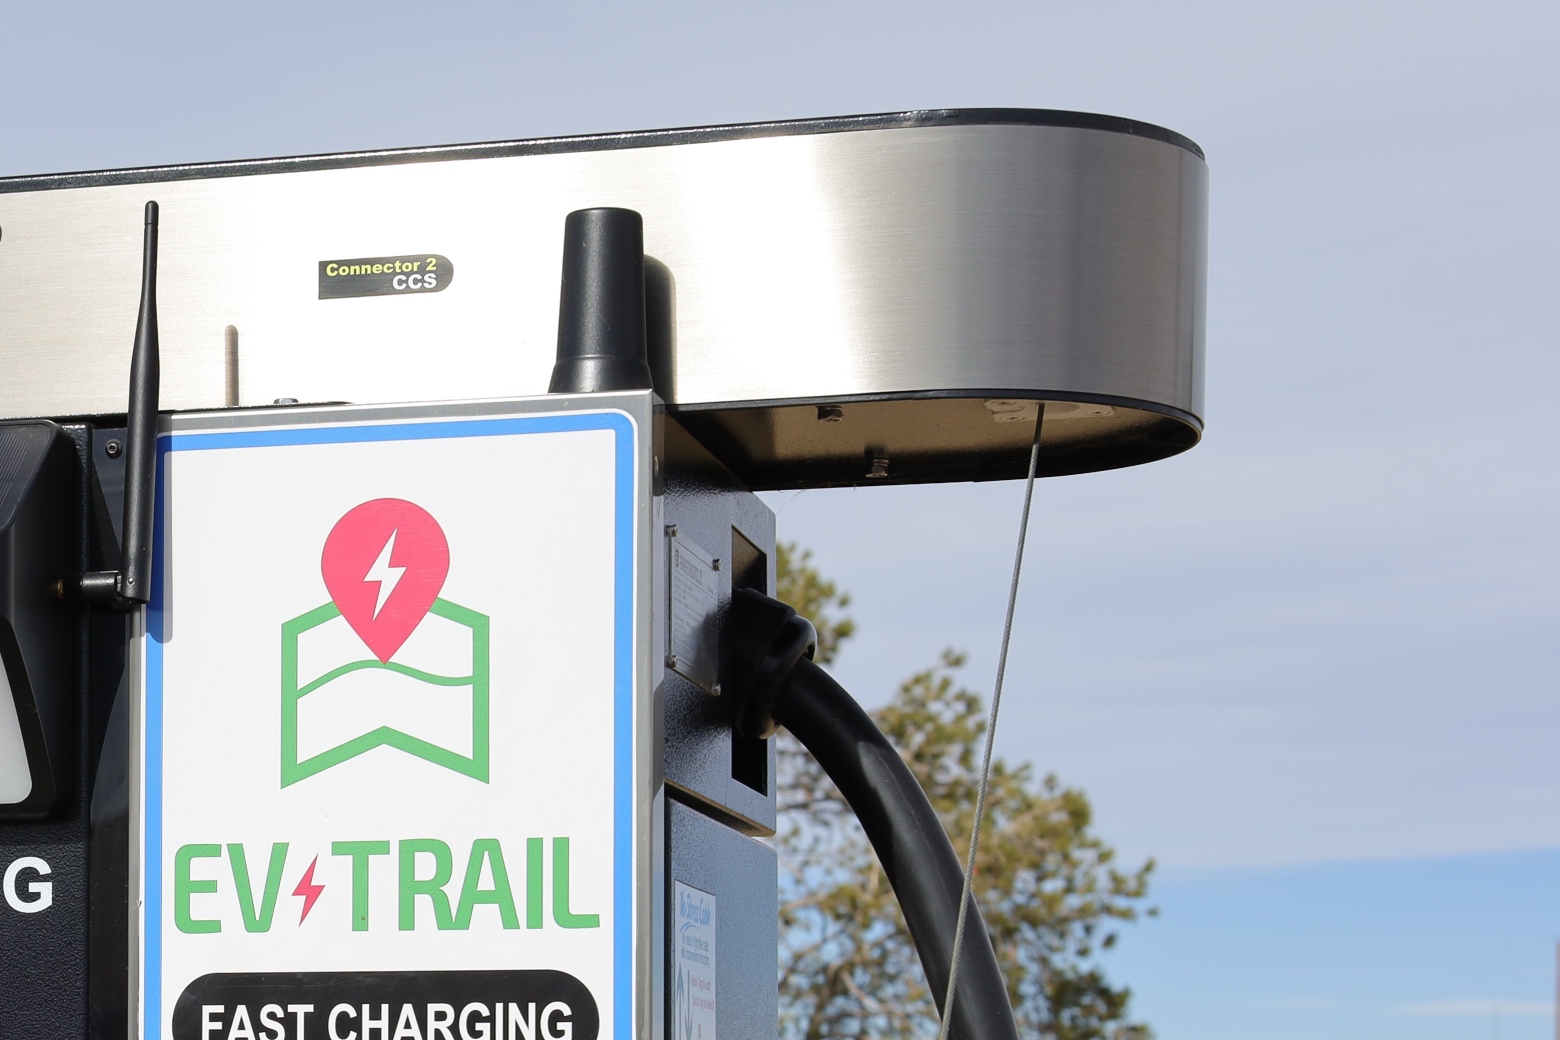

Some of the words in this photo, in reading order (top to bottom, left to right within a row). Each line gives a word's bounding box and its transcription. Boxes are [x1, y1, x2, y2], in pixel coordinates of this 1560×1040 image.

[326, 260, 420, 276] Connector
[426, 258, 437, 270] 2
[393, 273, 437, 290] CCS
[174, 842, 289, 934] EV
[331, 837, 600, 931] TRAIL
